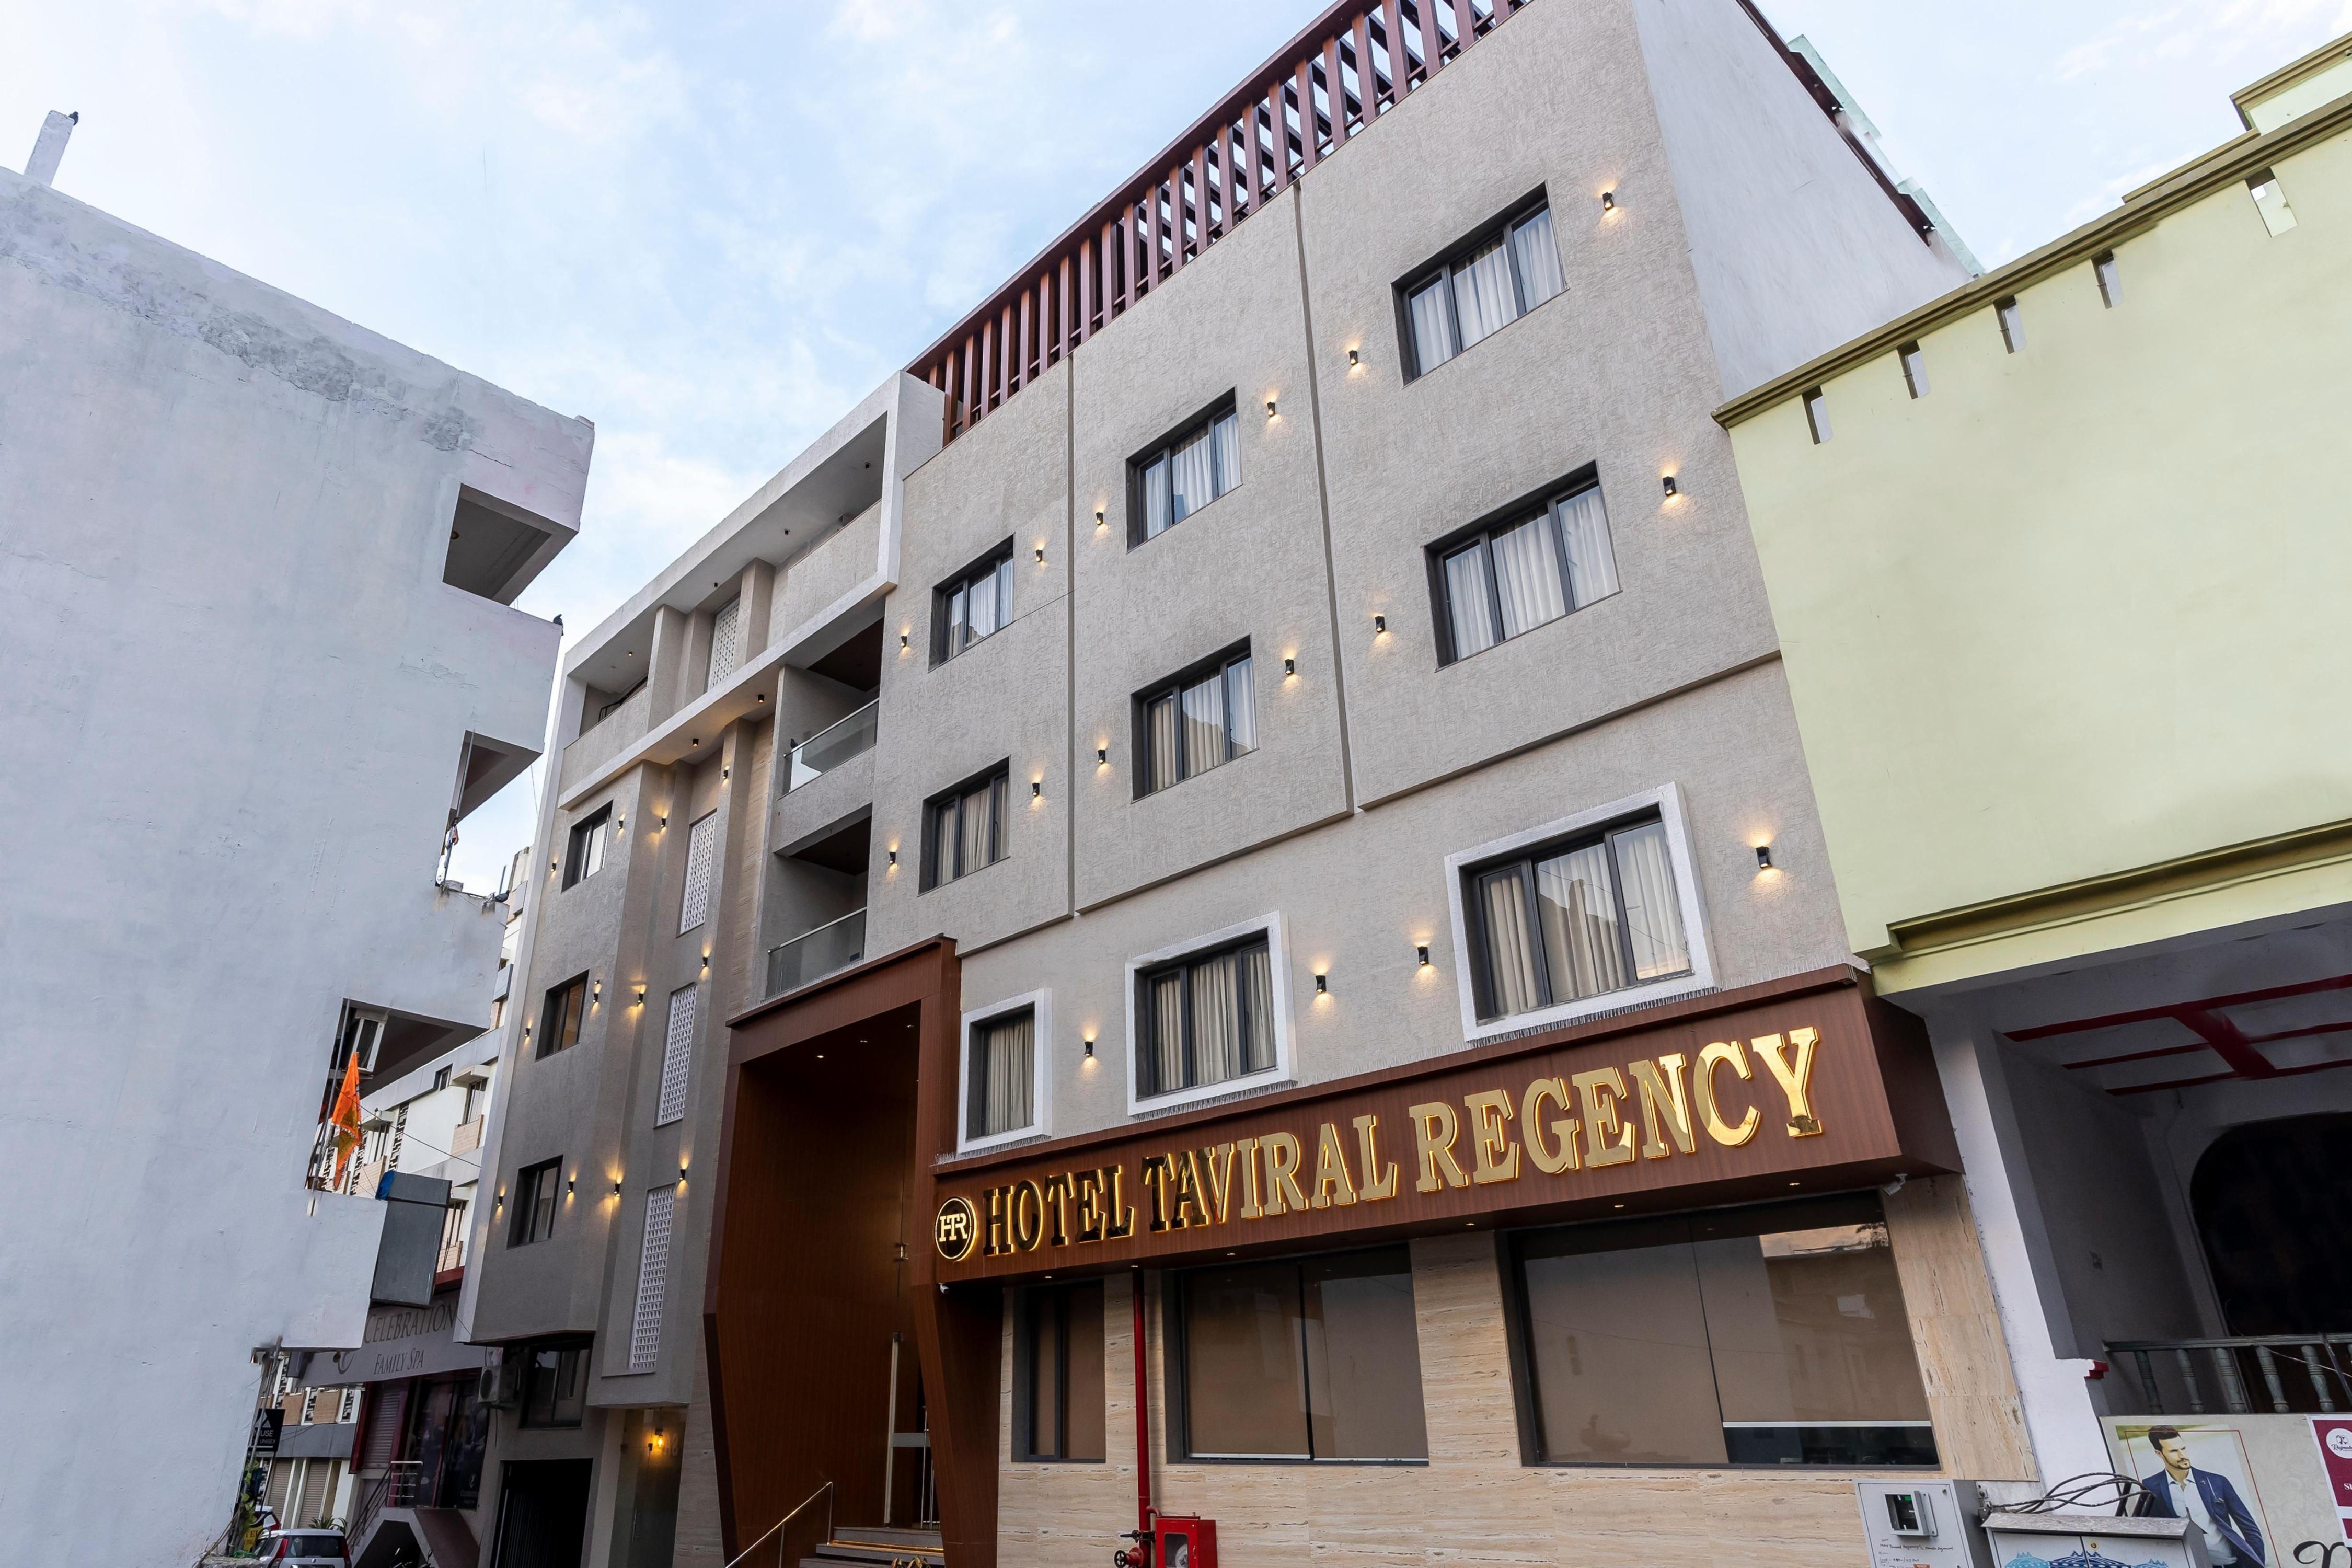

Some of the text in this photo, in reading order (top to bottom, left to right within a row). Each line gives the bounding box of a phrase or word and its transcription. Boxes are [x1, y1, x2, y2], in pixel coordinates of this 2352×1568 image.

[983, 1026, 1821, 1256] HOTEL TAVIRAL REGENCY
[364, 1300, 458, 1344] CELEBRATION
[373, 1347, 424, 1375] FAMILY SPA
